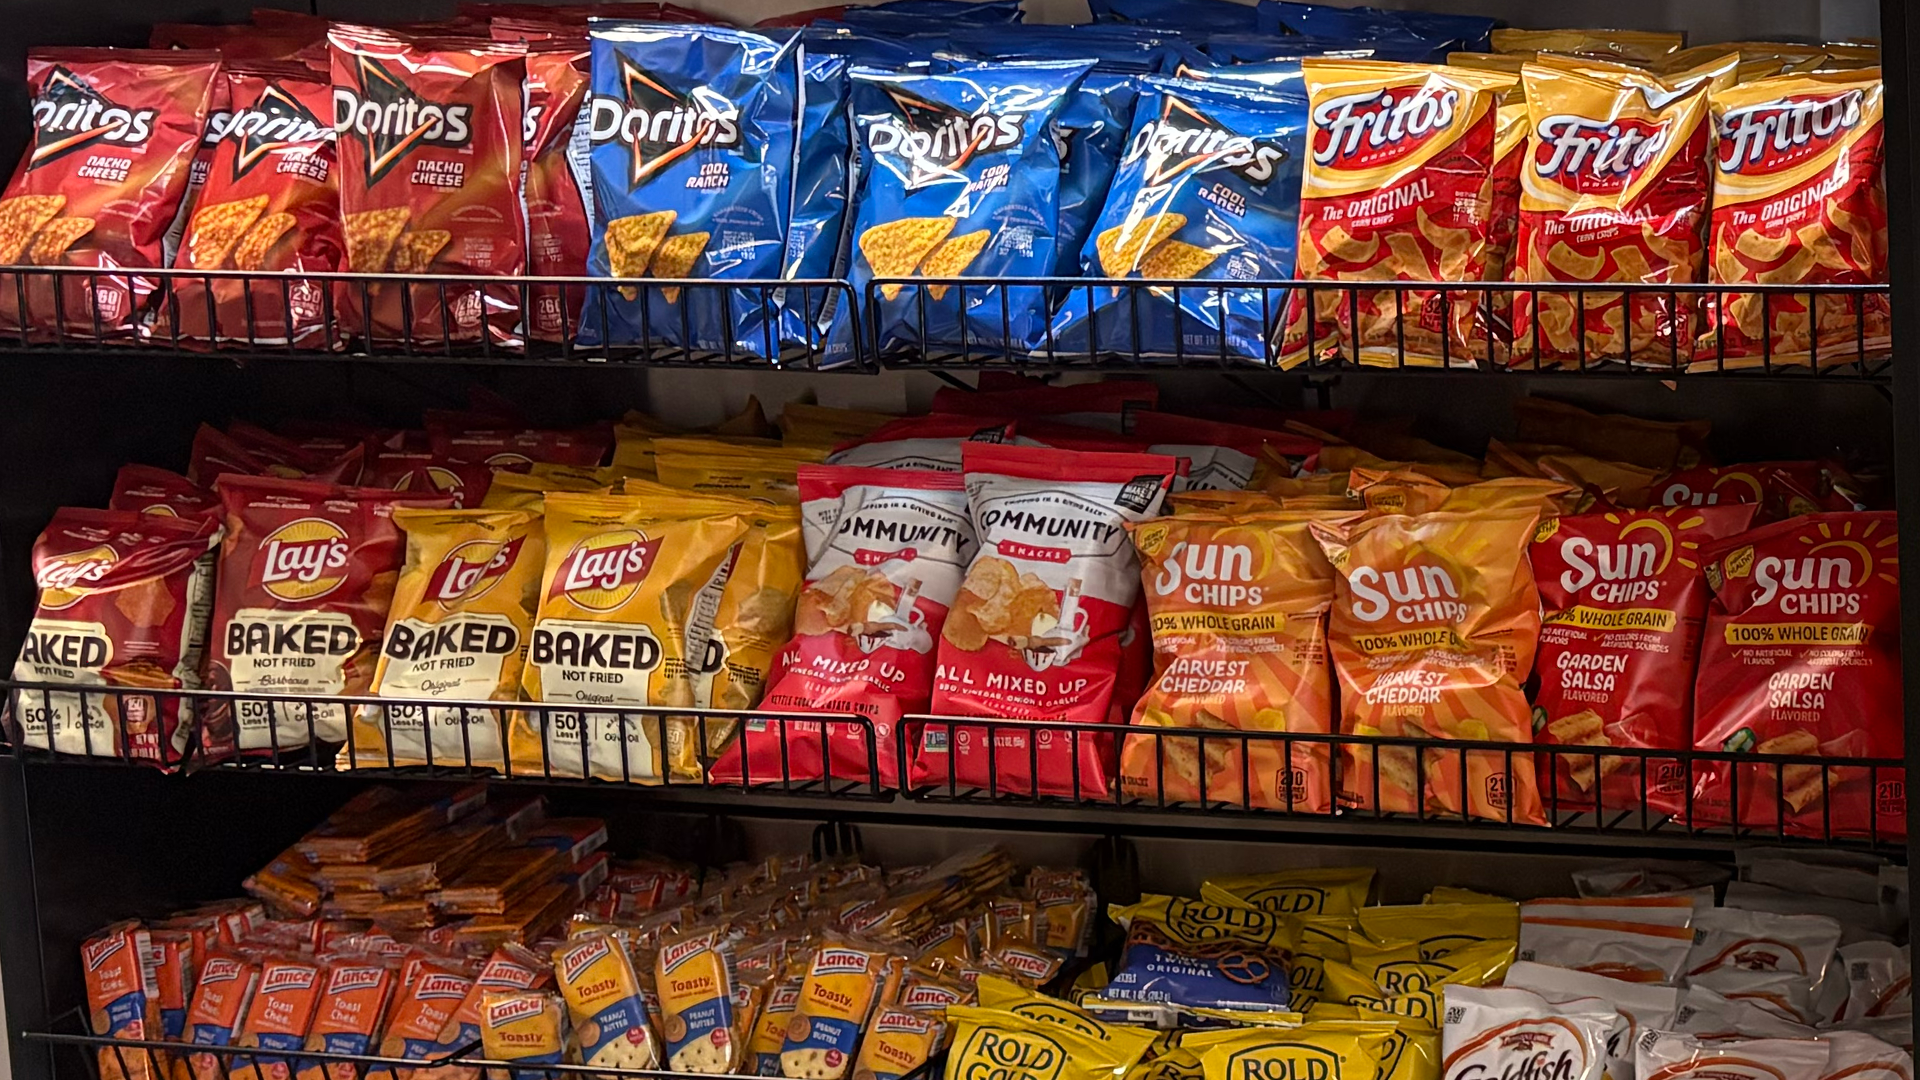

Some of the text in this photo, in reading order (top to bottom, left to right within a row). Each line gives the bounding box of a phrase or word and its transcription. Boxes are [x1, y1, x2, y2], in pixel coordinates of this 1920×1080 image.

[32, 99, 154, 144] oritos
[333, 89, 470, 142] Doritos
[591, 99, 739, 145] Doritos
[868, 114, 1023, 158] Doritos
[1313, 88, 1459, 165] Fritos
[1719, 89, 1865, 174] Fritos
[1124, 121, 1283, 181] Doritos
[1361, 146, 1406, 164] BRAND
[1537, 115, 1674, 177] Fritos
[86, 156, 132, 171] NACHO
[282, 151, 329, 169] NACHO
[416, 160, 464, 174] NACHO
[700, 163, 729, 176] COOL
[77, 165, 128, 181] CHEESE
[276, 163, 328, 182] CHEESE
[411, 173, 463, 186] CHEESE
[686, 176, 730, 190] RANCH
[1198, 187, 1245, 218] RANCH
[1213, 183, 1246, 207] COOL
[1322, 204, 1344, 222] The
[1346, 178, 1436, 219] ORIGINAL
[1732, 209, 1757, 226] The
[1545, 219, 1565, 237] The
[979, 509, 1120, 546] COMMUNITY
[262, 536, 349, 582] Lay's
[1008, 544, 1061, 559] SNACKS
[564, 540, 646, 592] Lay's
[1155, 541, 1254, 596] Sun
[1560, 536, 1658, 595] Sun
[1752, 556, 1853, 607] Sun
[1185, 582, 1264, 607] CHIPS
[1349, 564, 1458, 622] Sun
[1590, 580, 1659, 604] CHIPS
[1779, 593, 1861, 616] CHIPS
[1181, 614, 1276, 632] WHOLE GRAIN
[1395, 604, 1468, 625] CHIPS
[1580, 610, 1667, 628] WHOLE GRAIN
[227, 623, 358, 656] BAKED
[385, 622, 517, 662] BAKED
[1356, 629, 1449, 653] 100% WHOLE
[1732, 626, 1869, 642] 100% WHOLE GRAIN
[23, 632, 106, 669] AKED
[533, 630, 660, 670] BAKED
[253, 657, 316, 669] NOT FRIED
[412, 656, 476, 673] NOT FRIED
[812, 655, 905, 683] MIXED UP
[1556, 651, 1629, 674] GARDEN
[420, 678, 462, 695] Original
[562, 669, 624, 685] NOT FRIED
[935, 664, 1088, 695] ALL MIXED UP
[1161, 677, 1246, 695] CHEDDAR
[1371, 669, 1449, 688] HARVEST
[1560, 669, 1615, 692] SALSA
[1768, 671, 1835, 692] GARDEN
[1006, 696, 1036, 706] ONION
[1366, 686, 1441, 706] CHEDDAR
[1562, 689, 1609, 704] FLAVORED
[1769, 691, 1825, 710] SALSA
[1382, 704, 1425, 717] FLAVORED
[1770, 709, 1821, 722] FLAVORED
[1879, 782, 1903, 799] 210
[1181, 904, 1266, 928] ROLD
[564, 940, 605, 973] Lance
[664, 937, 708, 966] Lance
[817, 951, 866, 969] Lance
[204, 961, 241, 980] Lance
[266, 969, 311, 986] Lance
[333, 967, 378, 986] Lance
[485, 965, 531, 982] Lance
[1146, 964, 1214, 978] ORIGINAL
[421, 976, 470, 993] Lance
[576, 977, 619, 998] Toasty.
[670, 975, 713, 993] Toasty.
[203, 986, 224, 1004] Toast
[267, 996, 294, 1013] Toast
[334, 997, 362, 1011] Toast
[813, 982, 853, 1008] Toasty.
[907, 986, 957, 1004] Lance
[420, 1002, 449, 1022] Toast
[490, 999, 540, 1021] Lance
[600, 1008, 627, 1023] PEANUT
[689, 1008, 716, 1021] PEANUT
[603, 1018, 629, 1034] BUTTER
[690, 1017, 716, 1030] BUTTER
[815, 1021, 842, 1037] PEANUT
[879, 1012, 925, 1028] Lance
[812, 1030, 837, 1046] BUTTER
[975, 1032, 1054, 1071] ROLD
[1243, 1057, 1329, 1080] ROLD
